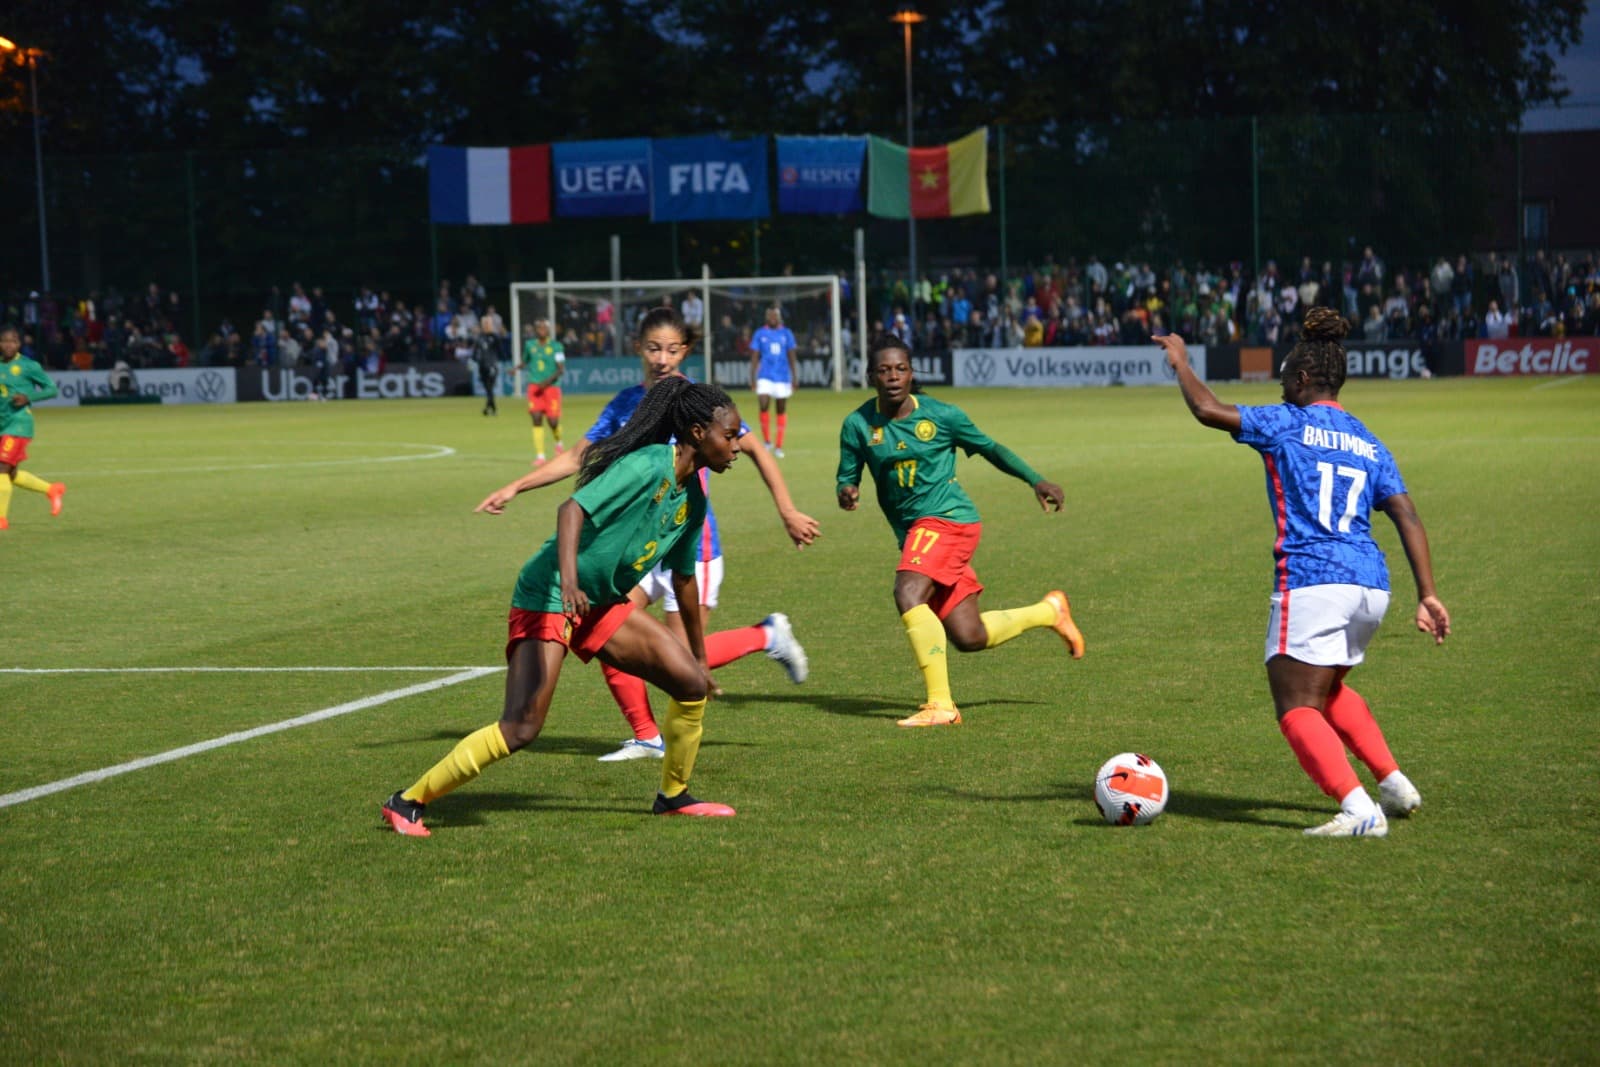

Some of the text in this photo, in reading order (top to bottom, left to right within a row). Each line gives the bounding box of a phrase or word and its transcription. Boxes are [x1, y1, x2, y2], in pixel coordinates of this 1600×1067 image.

[560, 164, 647, 193] UEFA
[669, 161, 750, 195] FIFA
[1005, 356, 1152, 379] Volkswagen
[1346, 349, 1427, 380] ange
[1474, 340, 1590, 374] Betclic
[356, 367, 446, 398] Eats
[1303, 424, 1379, 462] BALTIMORE
[895, 459, 917, 488] 17
[1317, 461, 1367, 533] 17
[911, 527, 940, 554] 17
[632, 541, 658, 572] 2
